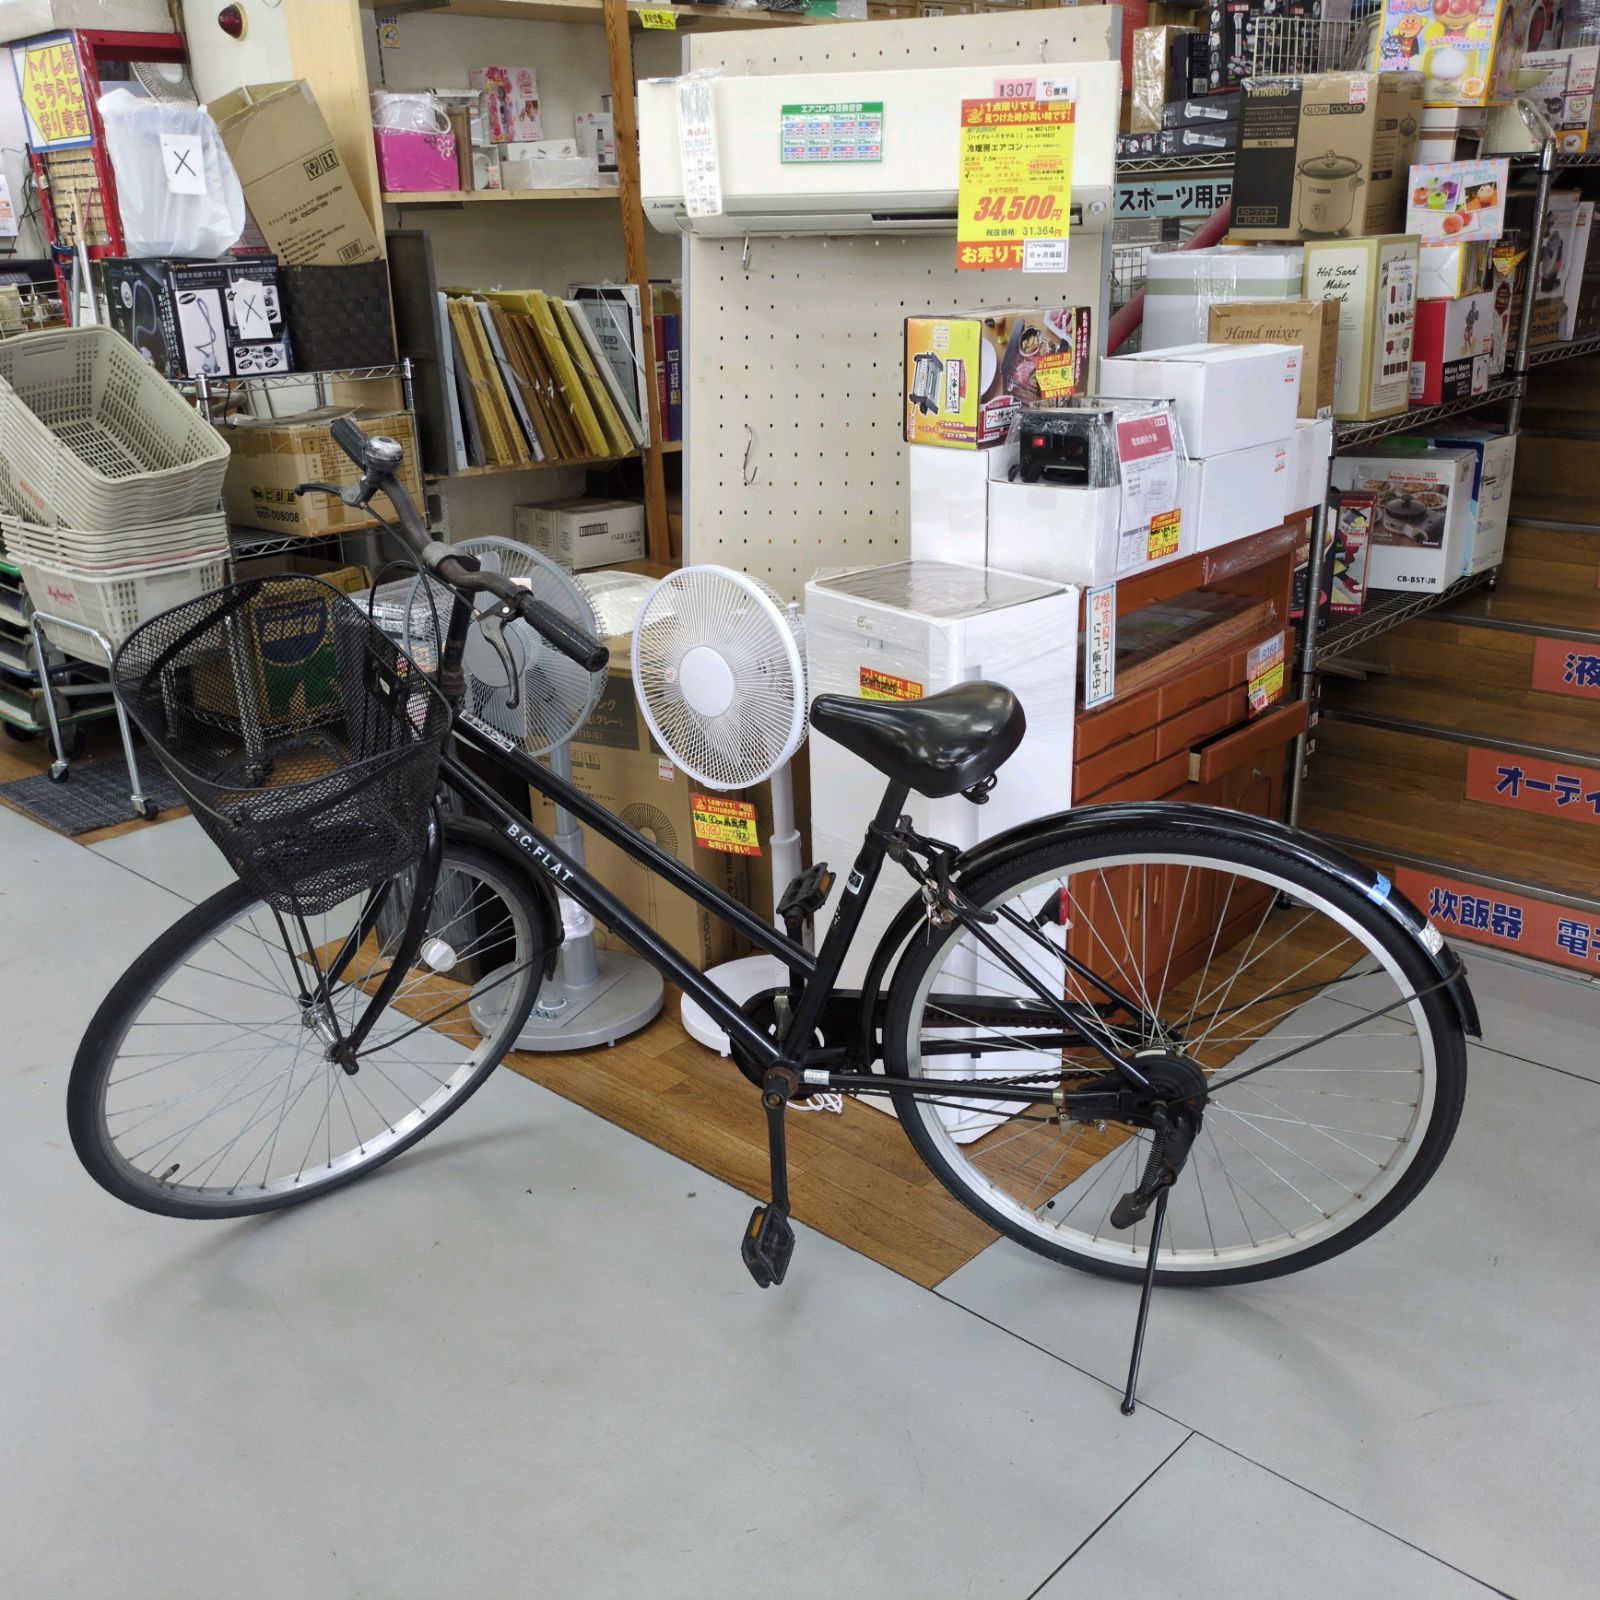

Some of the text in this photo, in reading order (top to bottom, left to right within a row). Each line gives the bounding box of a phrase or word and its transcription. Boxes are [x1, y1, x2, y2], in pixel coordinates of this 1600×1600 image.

[1306, 103, 1364, 114] SLOW COOKER
[967, 143, 1023, 152] 冷暖房エアコン
[1119, 184, 1232, 211] スポーツ用品
[973, 194, 1063, 222] 34,500円
[1315, 265, 1360, 278] Hot Sand
[1322, 279, 1351, 291] Maker
[1224, 324, 1304, 342] Hand mixer
[1396, 574, 1437, 585] CB-BST-JR
[506, 823, 575, 882] B.C.FLAT
[1428, 887, 1600, 962] 炊飯器 電
